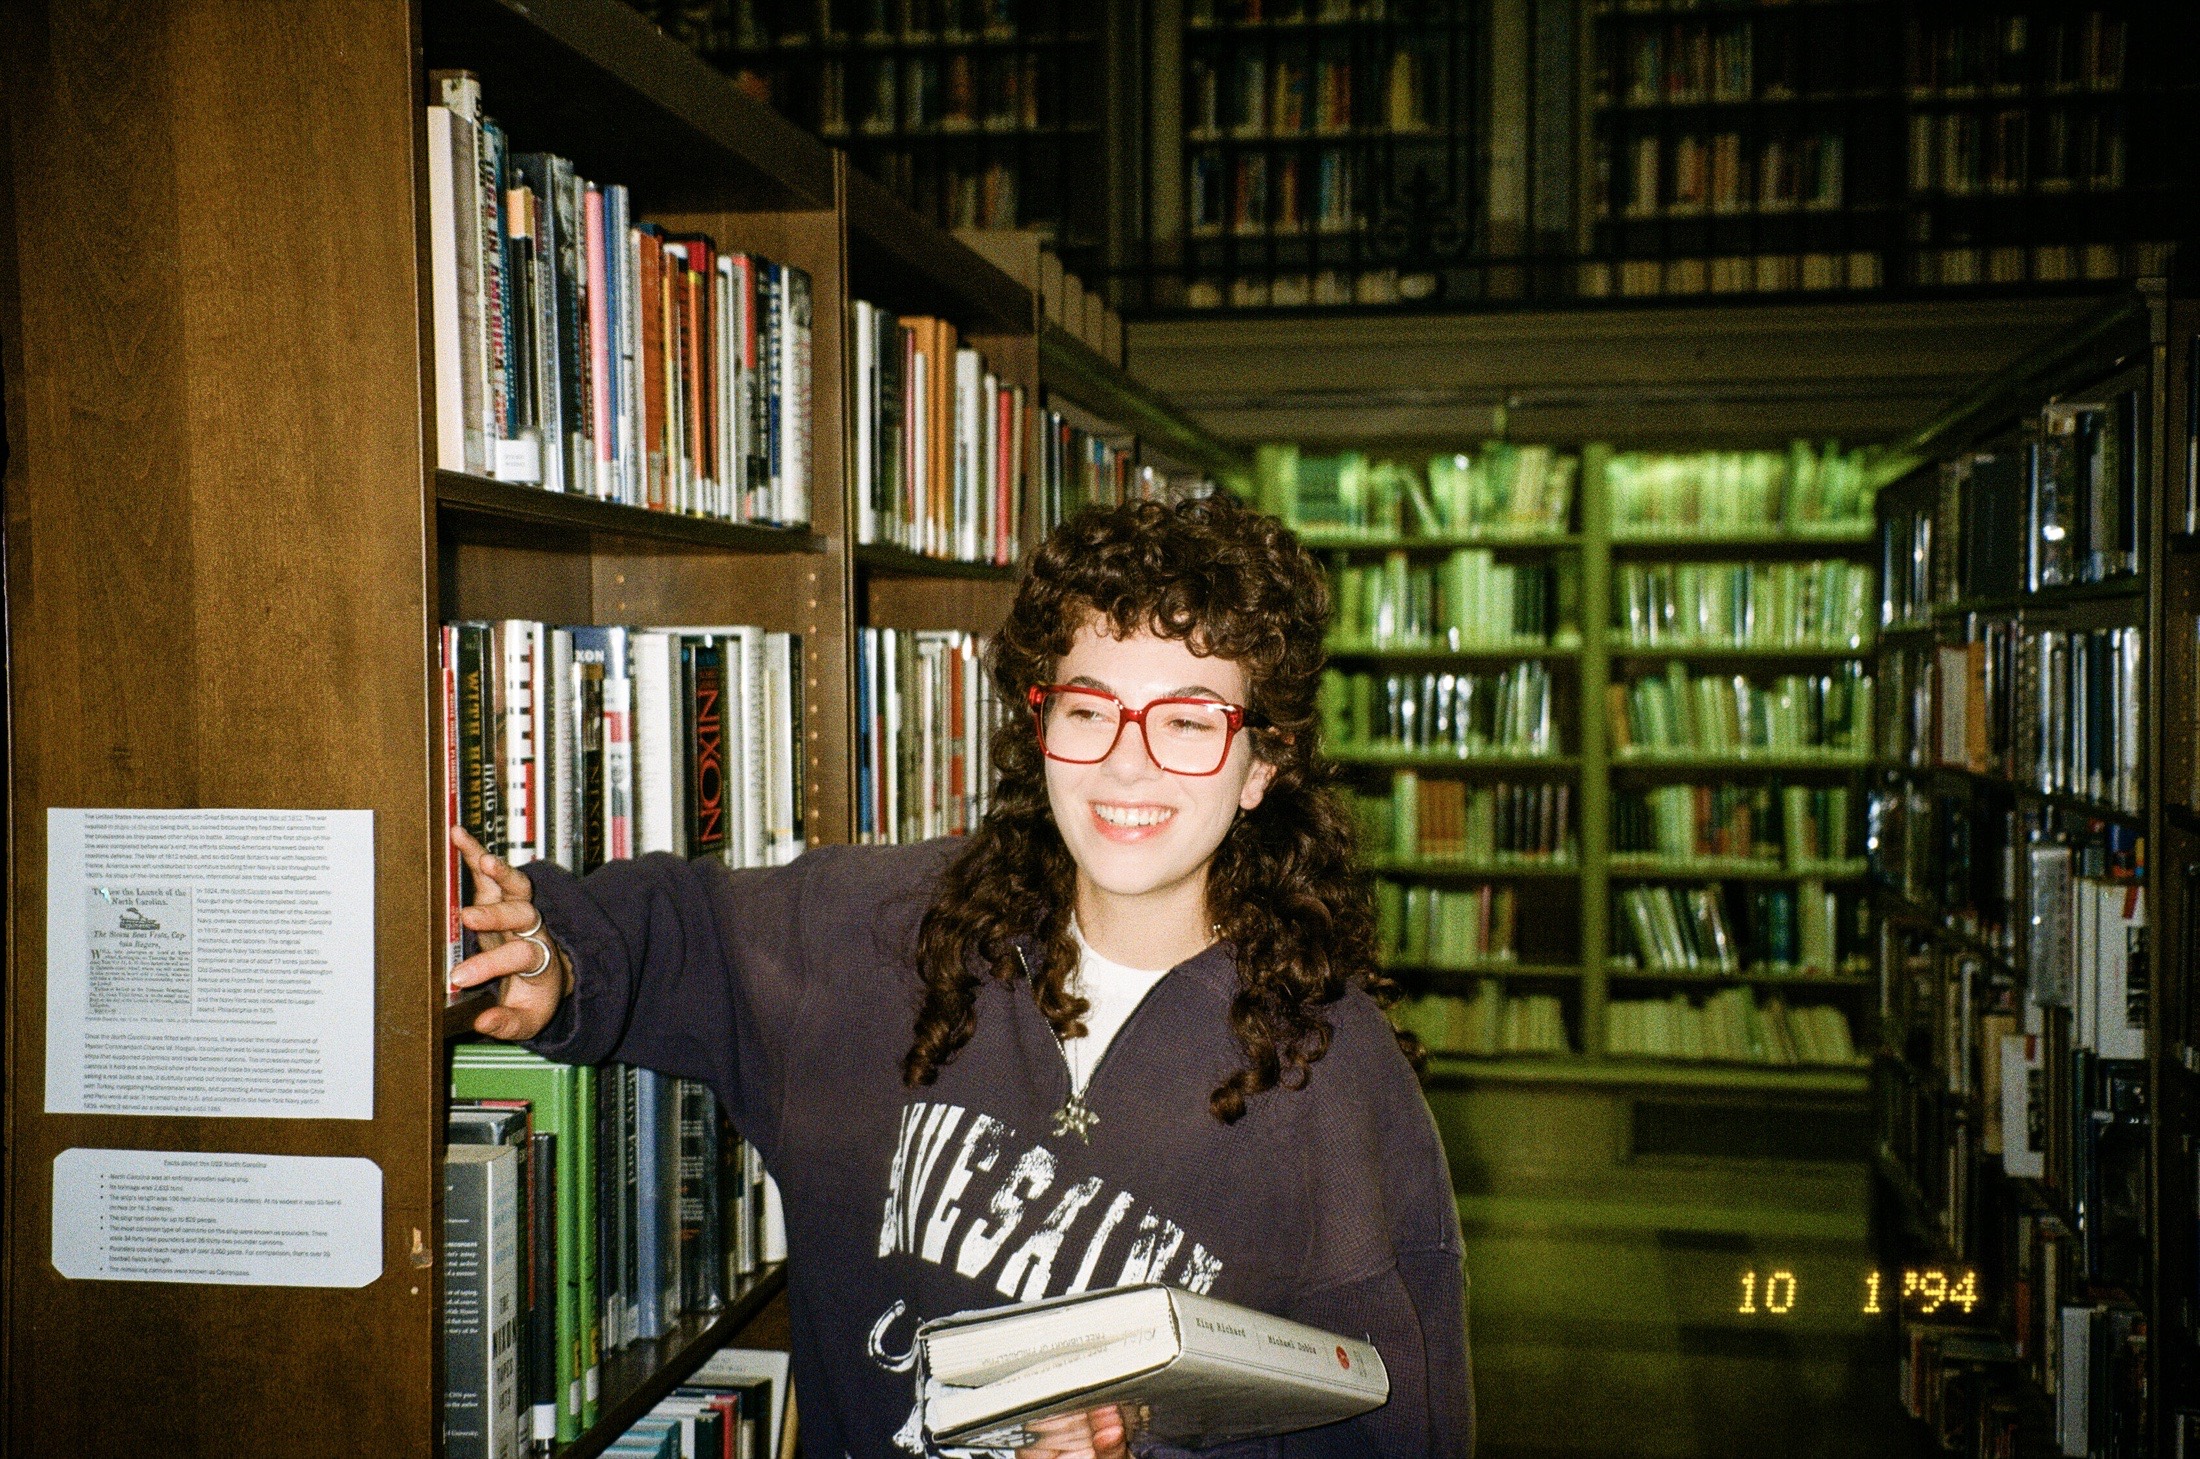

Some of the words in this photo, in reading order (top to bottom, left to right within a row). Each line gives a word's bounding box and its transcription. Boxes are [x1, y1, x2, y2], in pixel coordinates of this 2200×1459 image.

[465, 671, 482, 737] WITH
[466, 746, 483, 826] HONOR
[696, 687, 723, 845] NIXON
[136, 888, 164, 896] Launch
[1195, 1317, 1214, 1333] King
[1217, 1320, 1246, 1338] Richard
[1267, 1334, 1296, 1349] Michael
